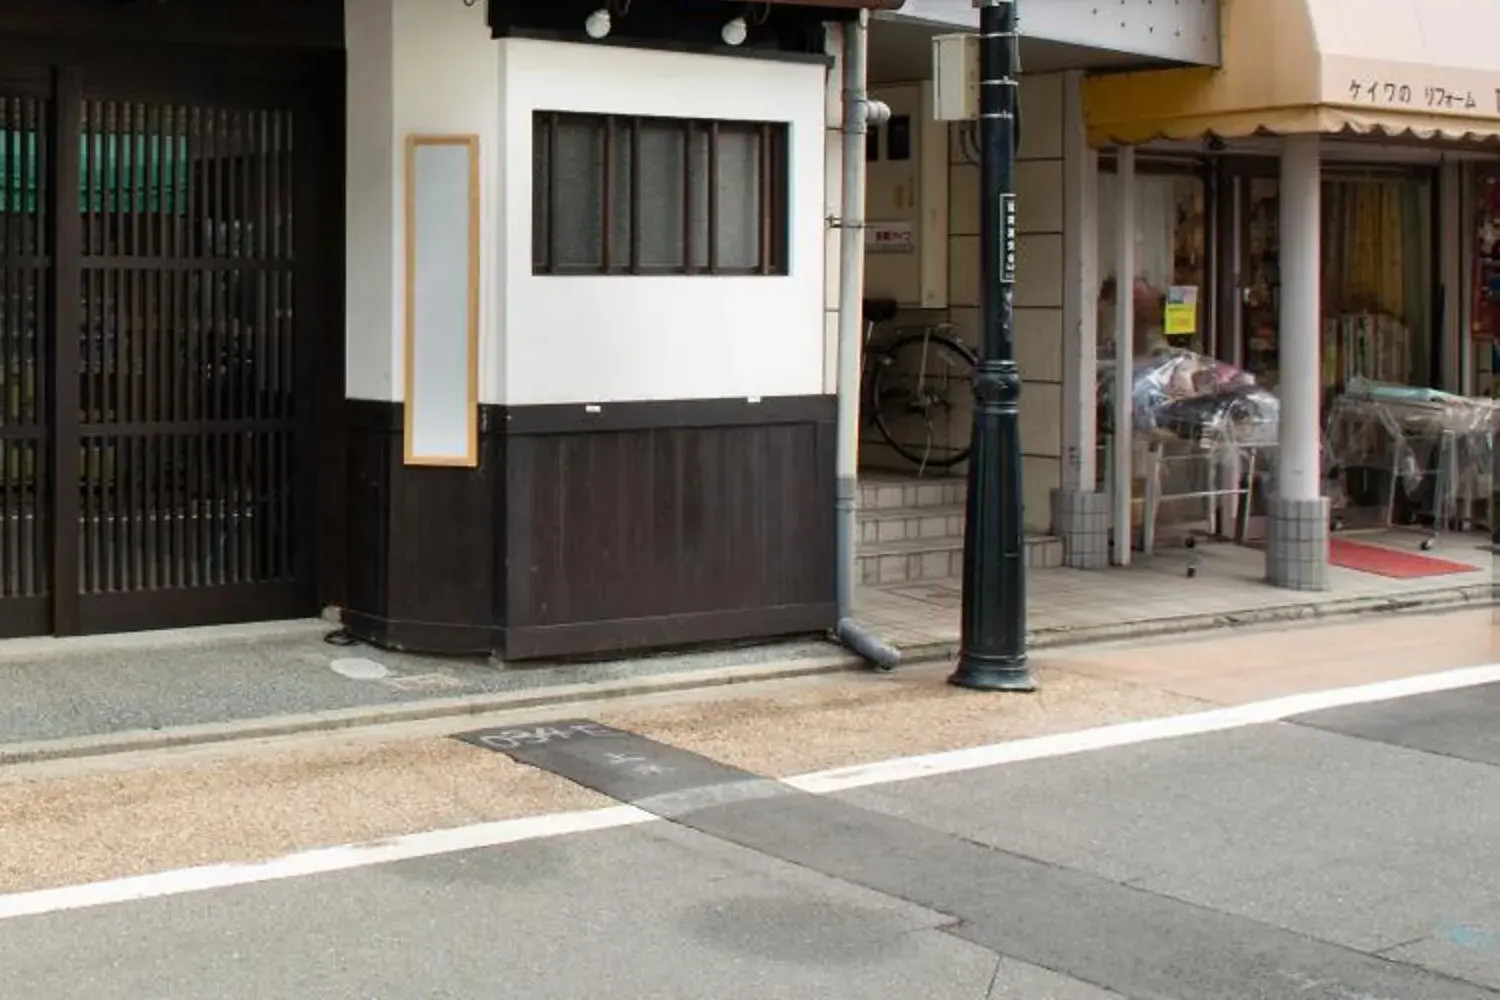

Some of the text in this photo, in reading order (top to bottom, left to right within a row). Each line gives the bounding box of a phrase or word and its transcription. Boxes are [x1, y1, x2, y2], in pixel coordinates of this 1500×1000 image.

[1349, 79, 1477, 109] ケイワの リフォーム
